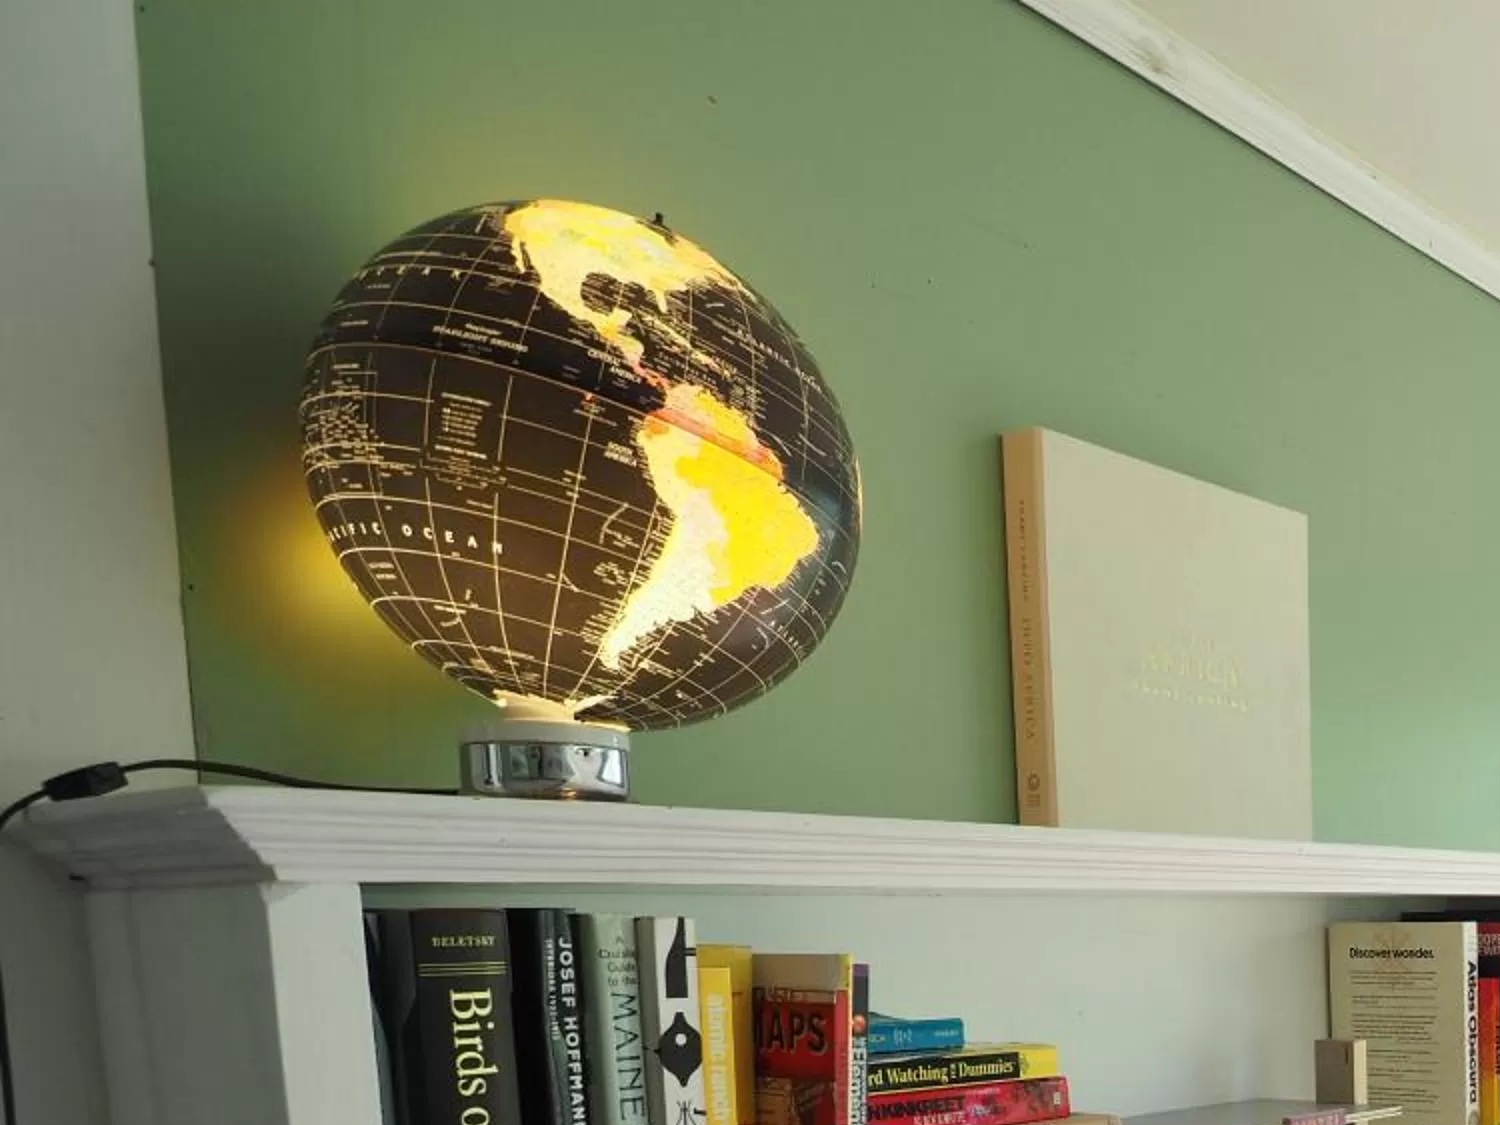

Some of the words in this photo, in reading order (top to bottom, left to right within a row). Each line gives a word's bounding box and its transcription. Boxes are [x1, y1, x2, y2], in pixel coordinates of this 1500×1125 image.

[402, 523, 503, 556] OCEAN
[431, 935, 497, 948] BELETSKY
[1349, 946, 1391, 959] Discover
[557, 937, 577, 1009] JOSEF
[1466, 959, 1478, 1011] Atlas
[449, 988, 499, 1097] Birds
[609, 992, 647, 1121] MAINE
[1467, 1014, 1478, 1105] Obscura
[868, 1071, 883, 1087] rd
[887, 1066, 949, 1085] Watching
[959, 1059, 1014, 1078] Dummies
